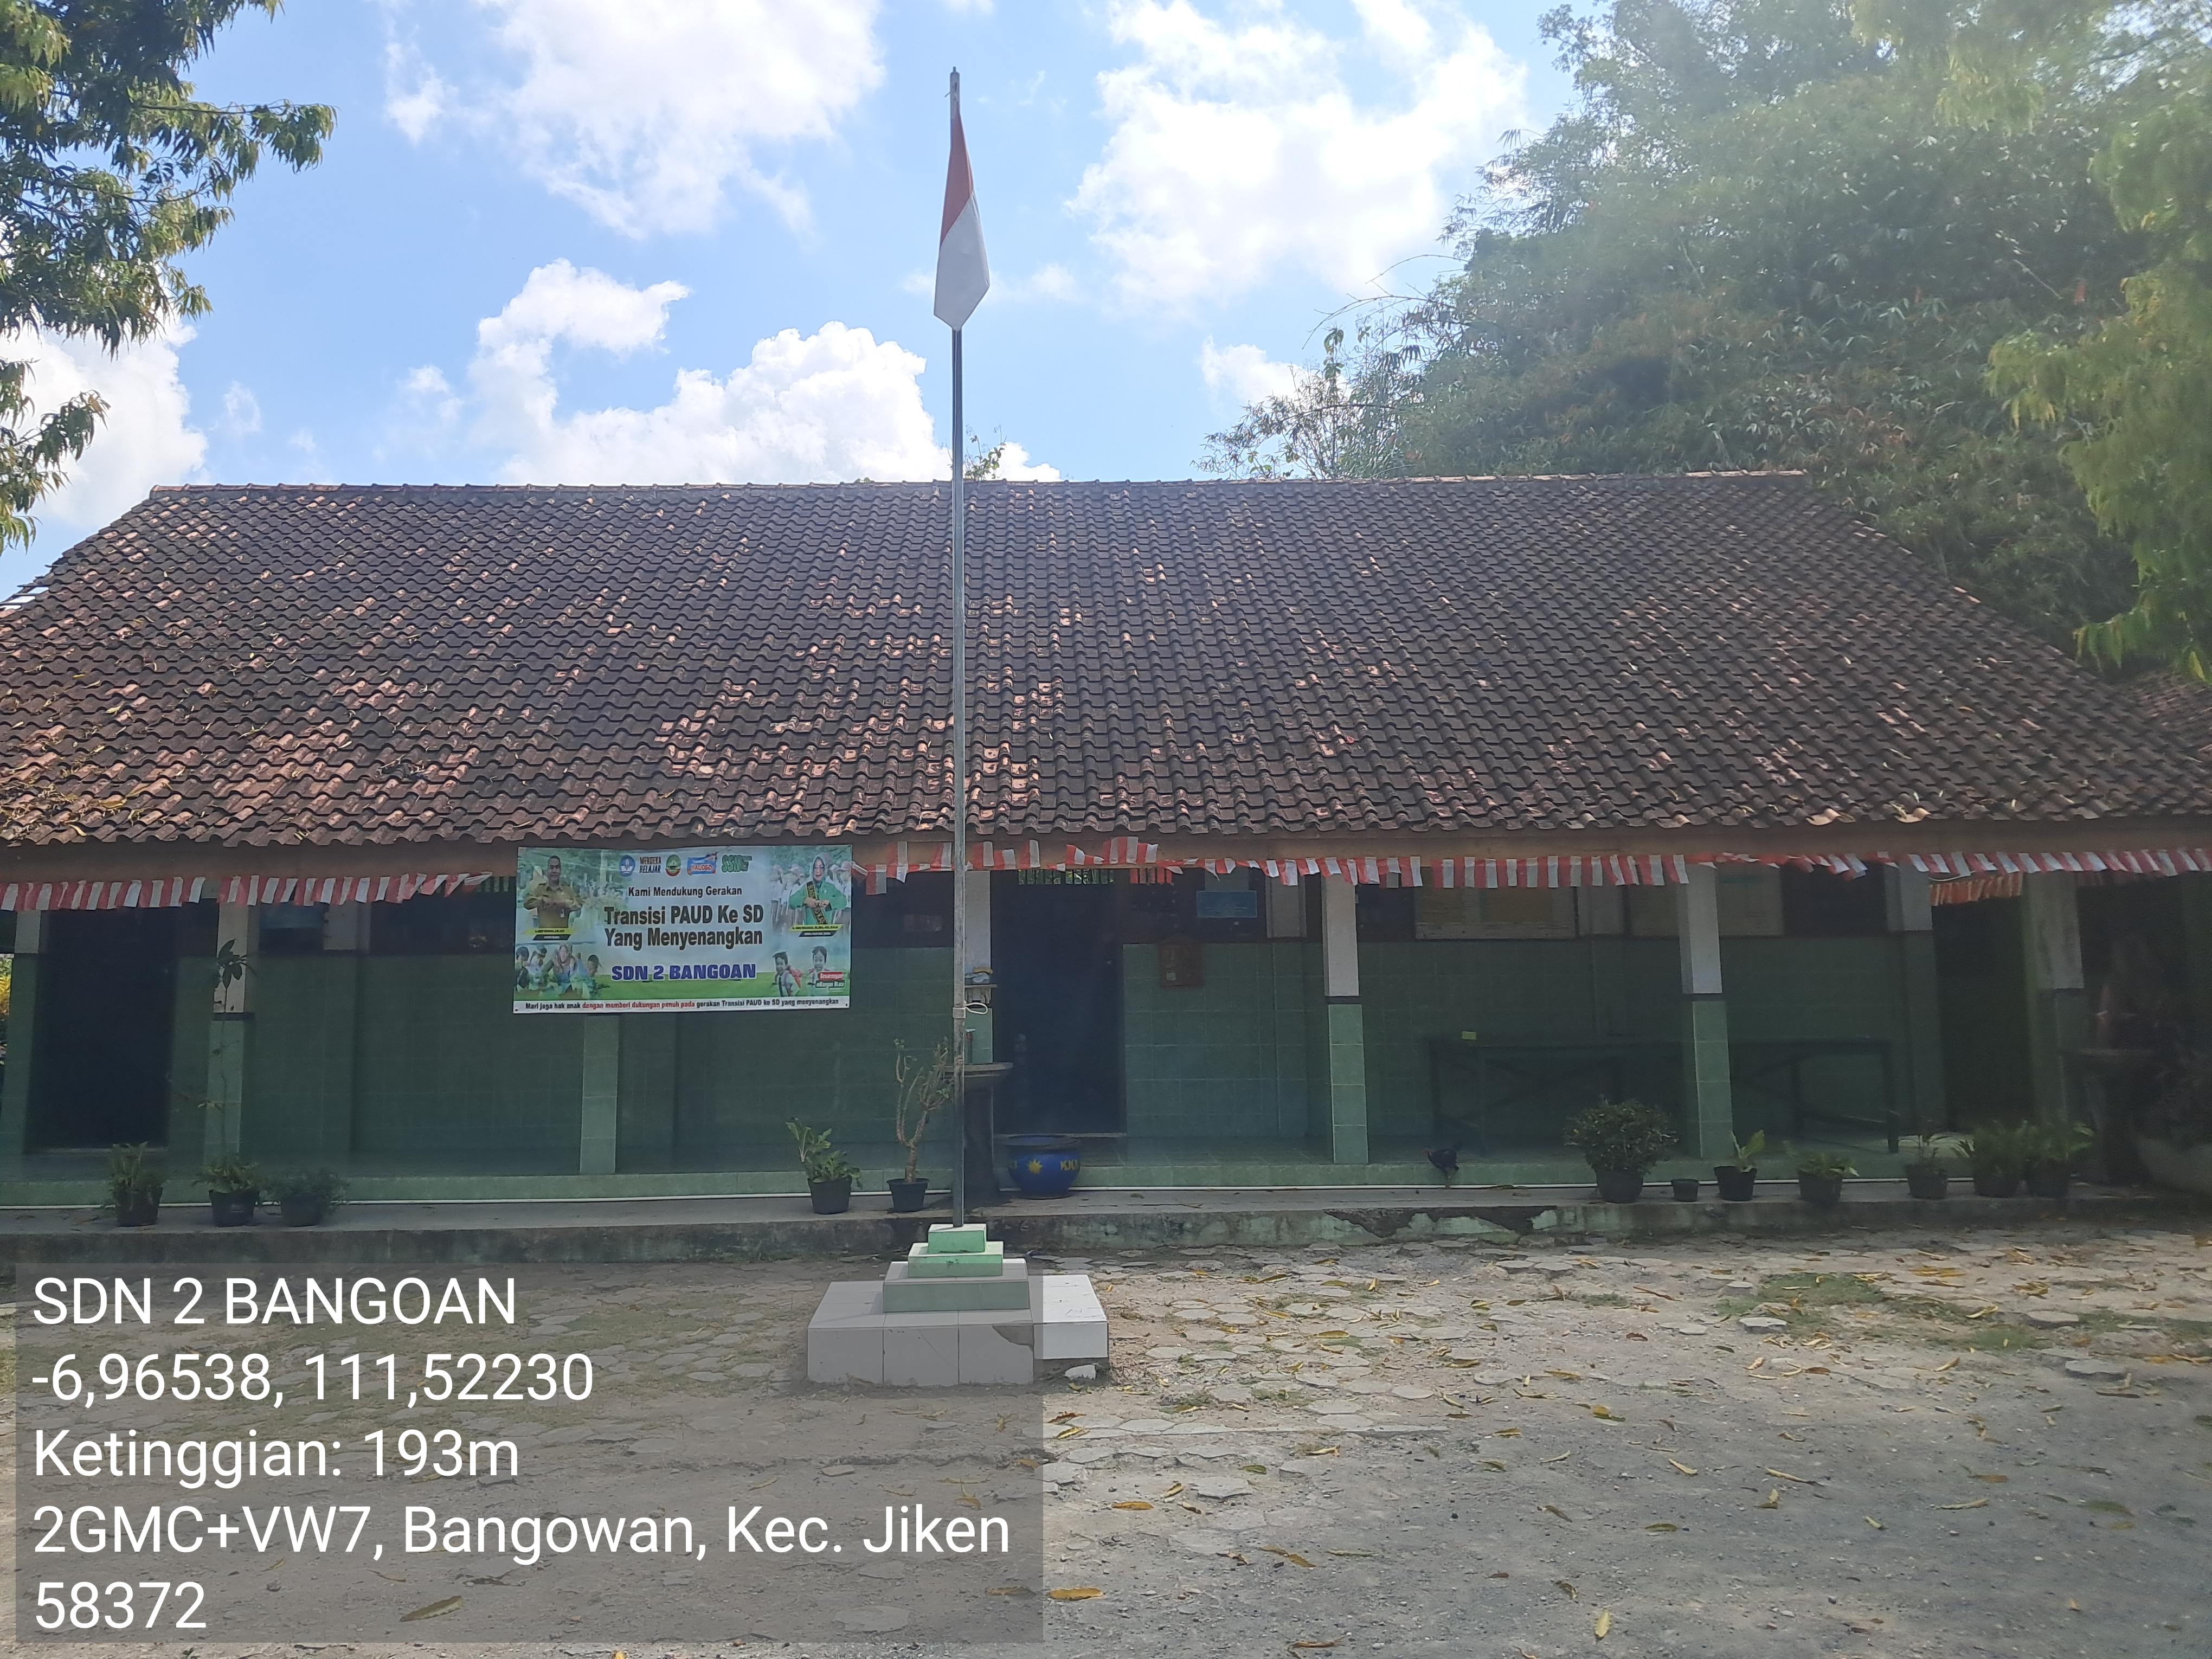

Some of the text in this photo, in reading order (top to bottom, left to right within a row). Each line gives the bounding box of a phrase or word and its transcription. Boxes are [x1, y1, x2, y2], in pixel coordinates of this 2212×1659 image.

[639, 865, 661, 873] BELAJAR
[628, 886, 742, 898] Kami Mendukung Gerakan
[605, 904, 764, 924] Transisi PAUD Ke SD
[605, 927, 763, 950] Yang Menyenangkan
[612, 964, 756, 980] SDN 2 BANGOAN
[661, 1001, 679, 1009] penuh
[697, 1000, 720, 1008] gerakan
[796, 998, 839, 1006] menyenangkan
